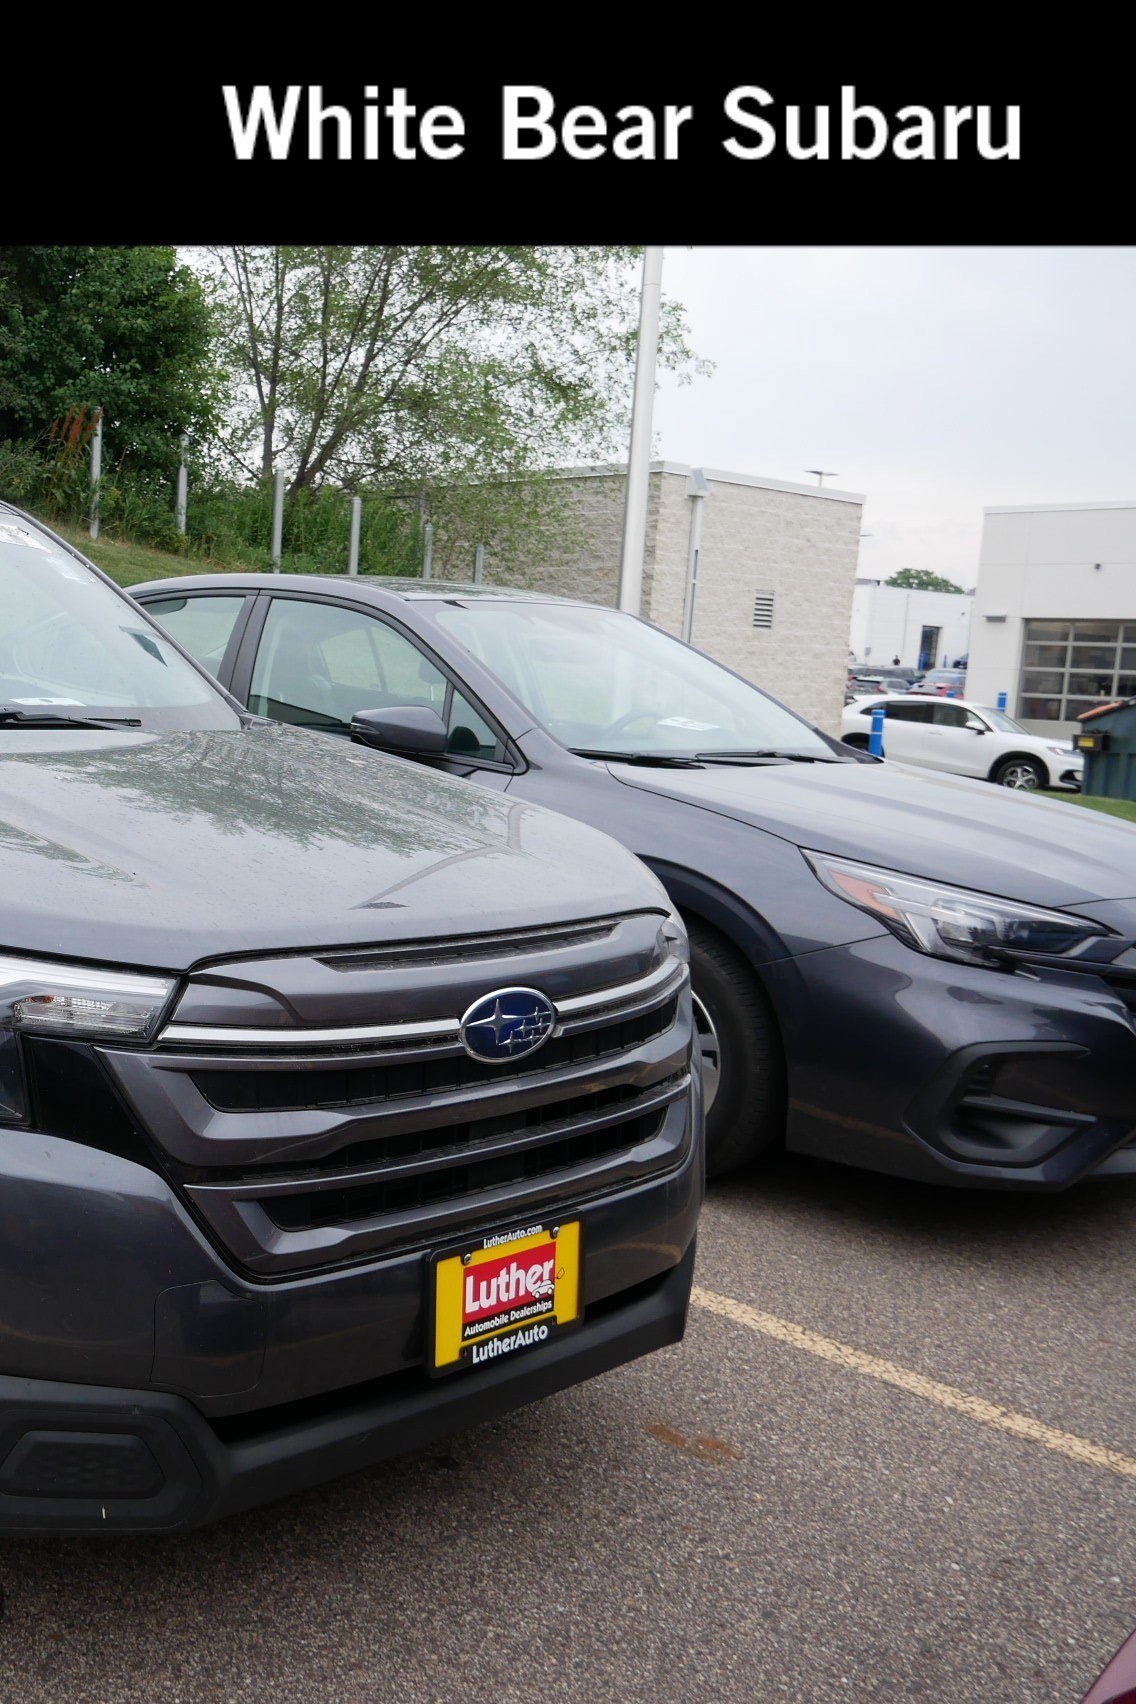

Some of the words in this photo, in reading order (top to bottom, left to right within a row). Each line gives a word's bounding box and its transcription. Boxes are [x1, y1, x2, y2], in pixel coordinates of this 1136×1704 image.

[483, 1224, 543, 1249] LutherAuto.com
[464, 1258, 555, 1315] Luther
[464, 1315, 509, 1337] Automobile
[510, 1299, 553, 1322] Dealerships
[472, 1324, 549, 1364] LutherAuto
